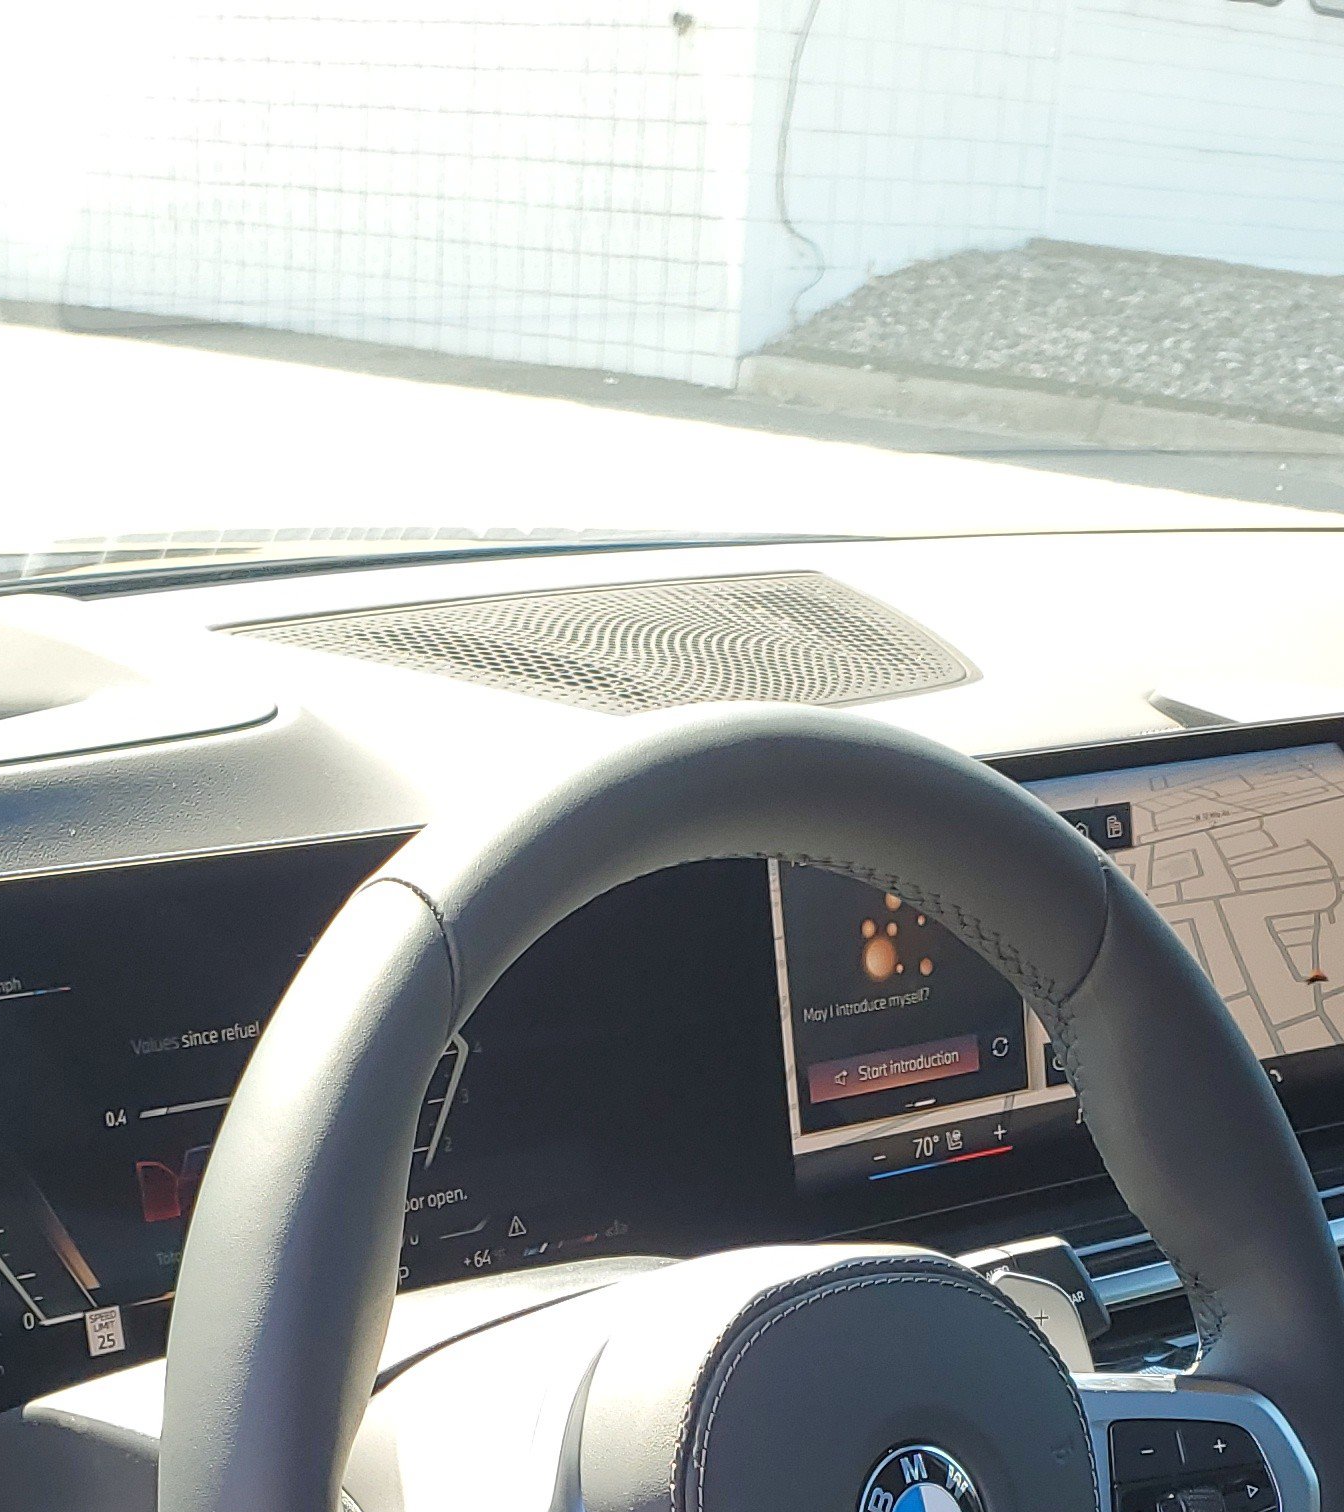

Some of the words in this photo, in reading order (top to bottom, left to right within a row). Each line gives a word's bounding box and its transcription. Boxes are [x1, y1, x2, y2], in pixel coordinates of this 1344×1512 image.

[803, 1008, 828, 1023] May
[836, 997, 887, 1017] introduce
[888, 986, 930, 1008] myself?
[181, 1029, 218, 1048] since
[221, 1020, 261, 1041] refuel
[858, 1063, 888, 1081] Start
[889, 1050, 960, 1076] introduction
[105, 1108, 128, 1127] 0.4
[404, 1195, 424, 1213] oor
[427, 1188, 468, 1210] open.
[23, 1312, 35, 1330] 0
[97, 1333, 116, 1350] 25
